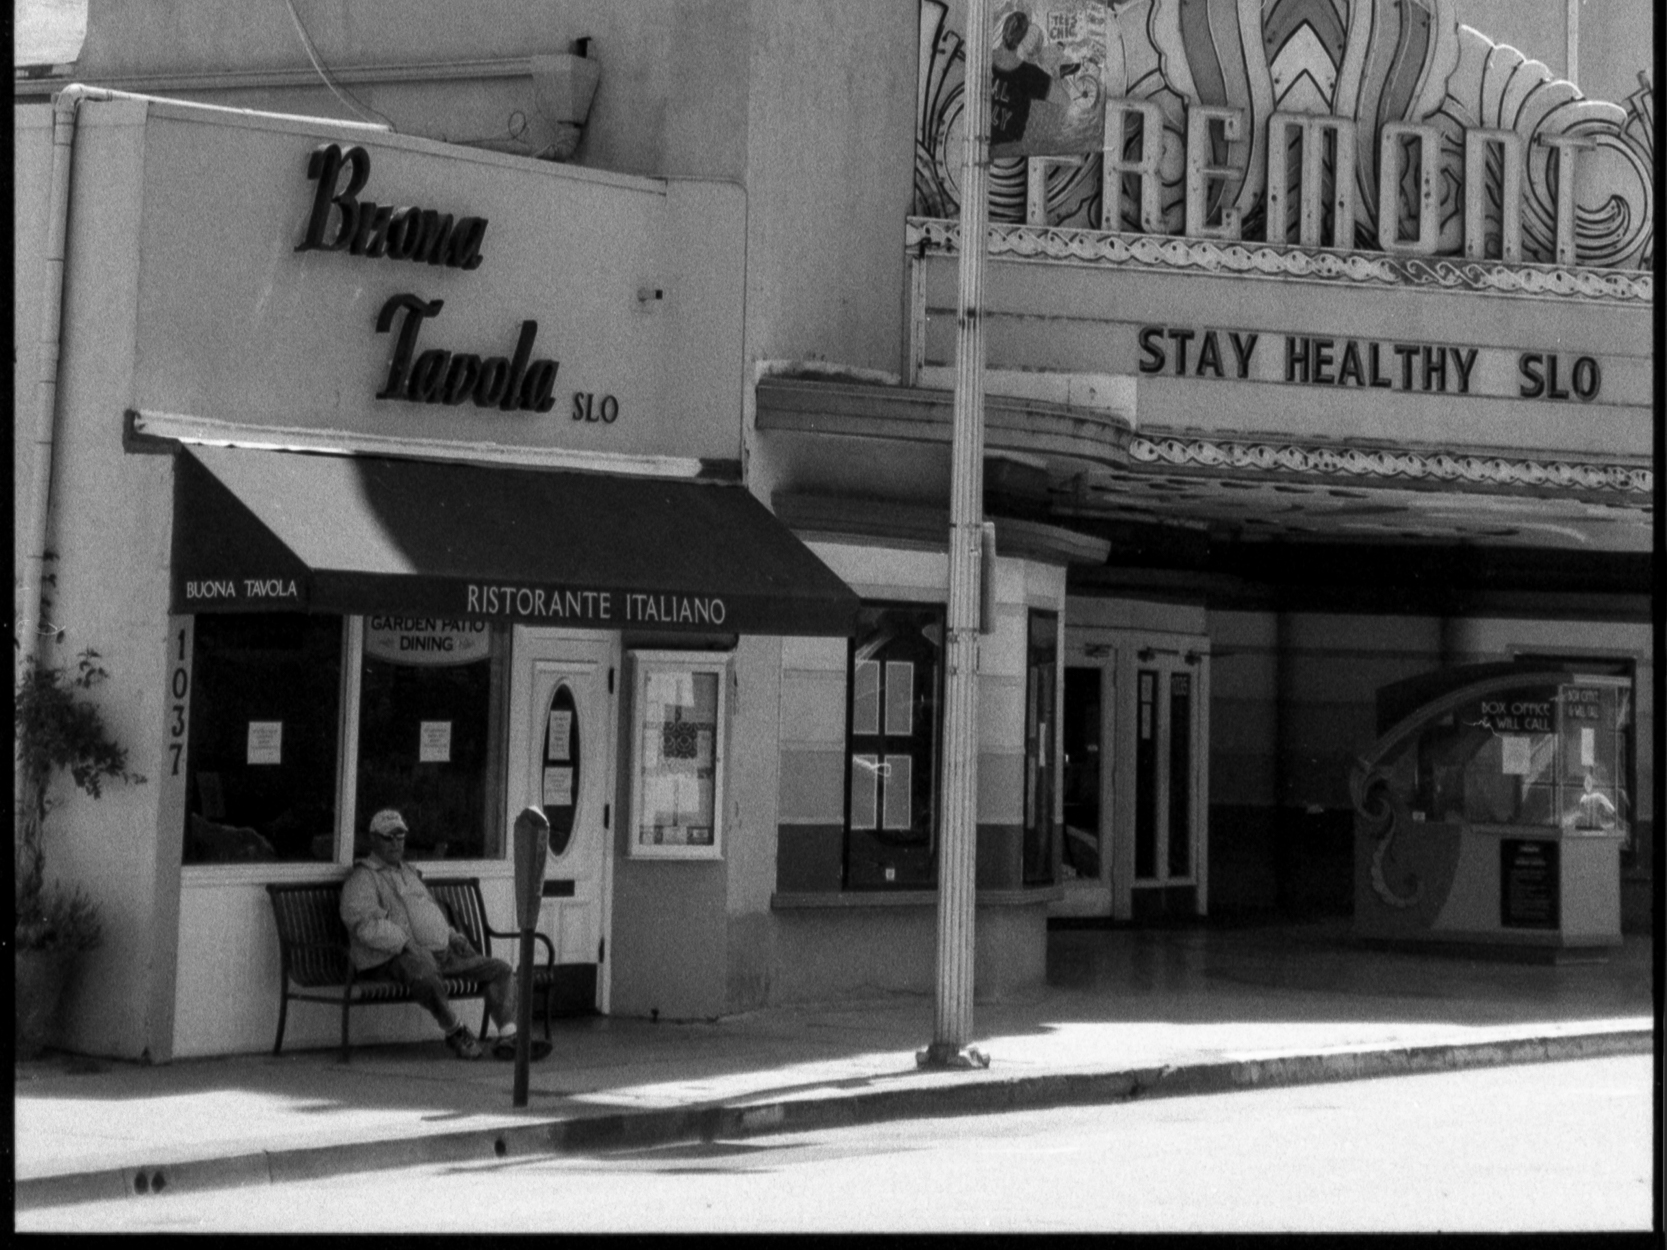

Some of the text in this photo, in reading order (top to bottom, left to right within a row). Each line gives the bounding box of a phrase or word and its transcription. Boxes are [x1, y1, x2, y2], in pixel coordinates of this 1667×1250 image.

[294, 144, 488, 270] Buona
[375, 293, 619, 424] Tavola SLO
[1138, 326, 1601, 401] STAY HEALTHY SLO
[186, 580, 298, 599] BUONA TAVOLA
[467, 585, 726, 625] RISTORANTE ITALIANO
[371, 615, 486, 633] GARDEN PATIO
[400, 636, 454, 652] DINING
[170, 627, 189, 777] 1037
[1481, 701, 1551, 716] BOX OFFICE
[1496, 716, 1520, 730] WILL
[1524, 717, 1551, 731] CALL
